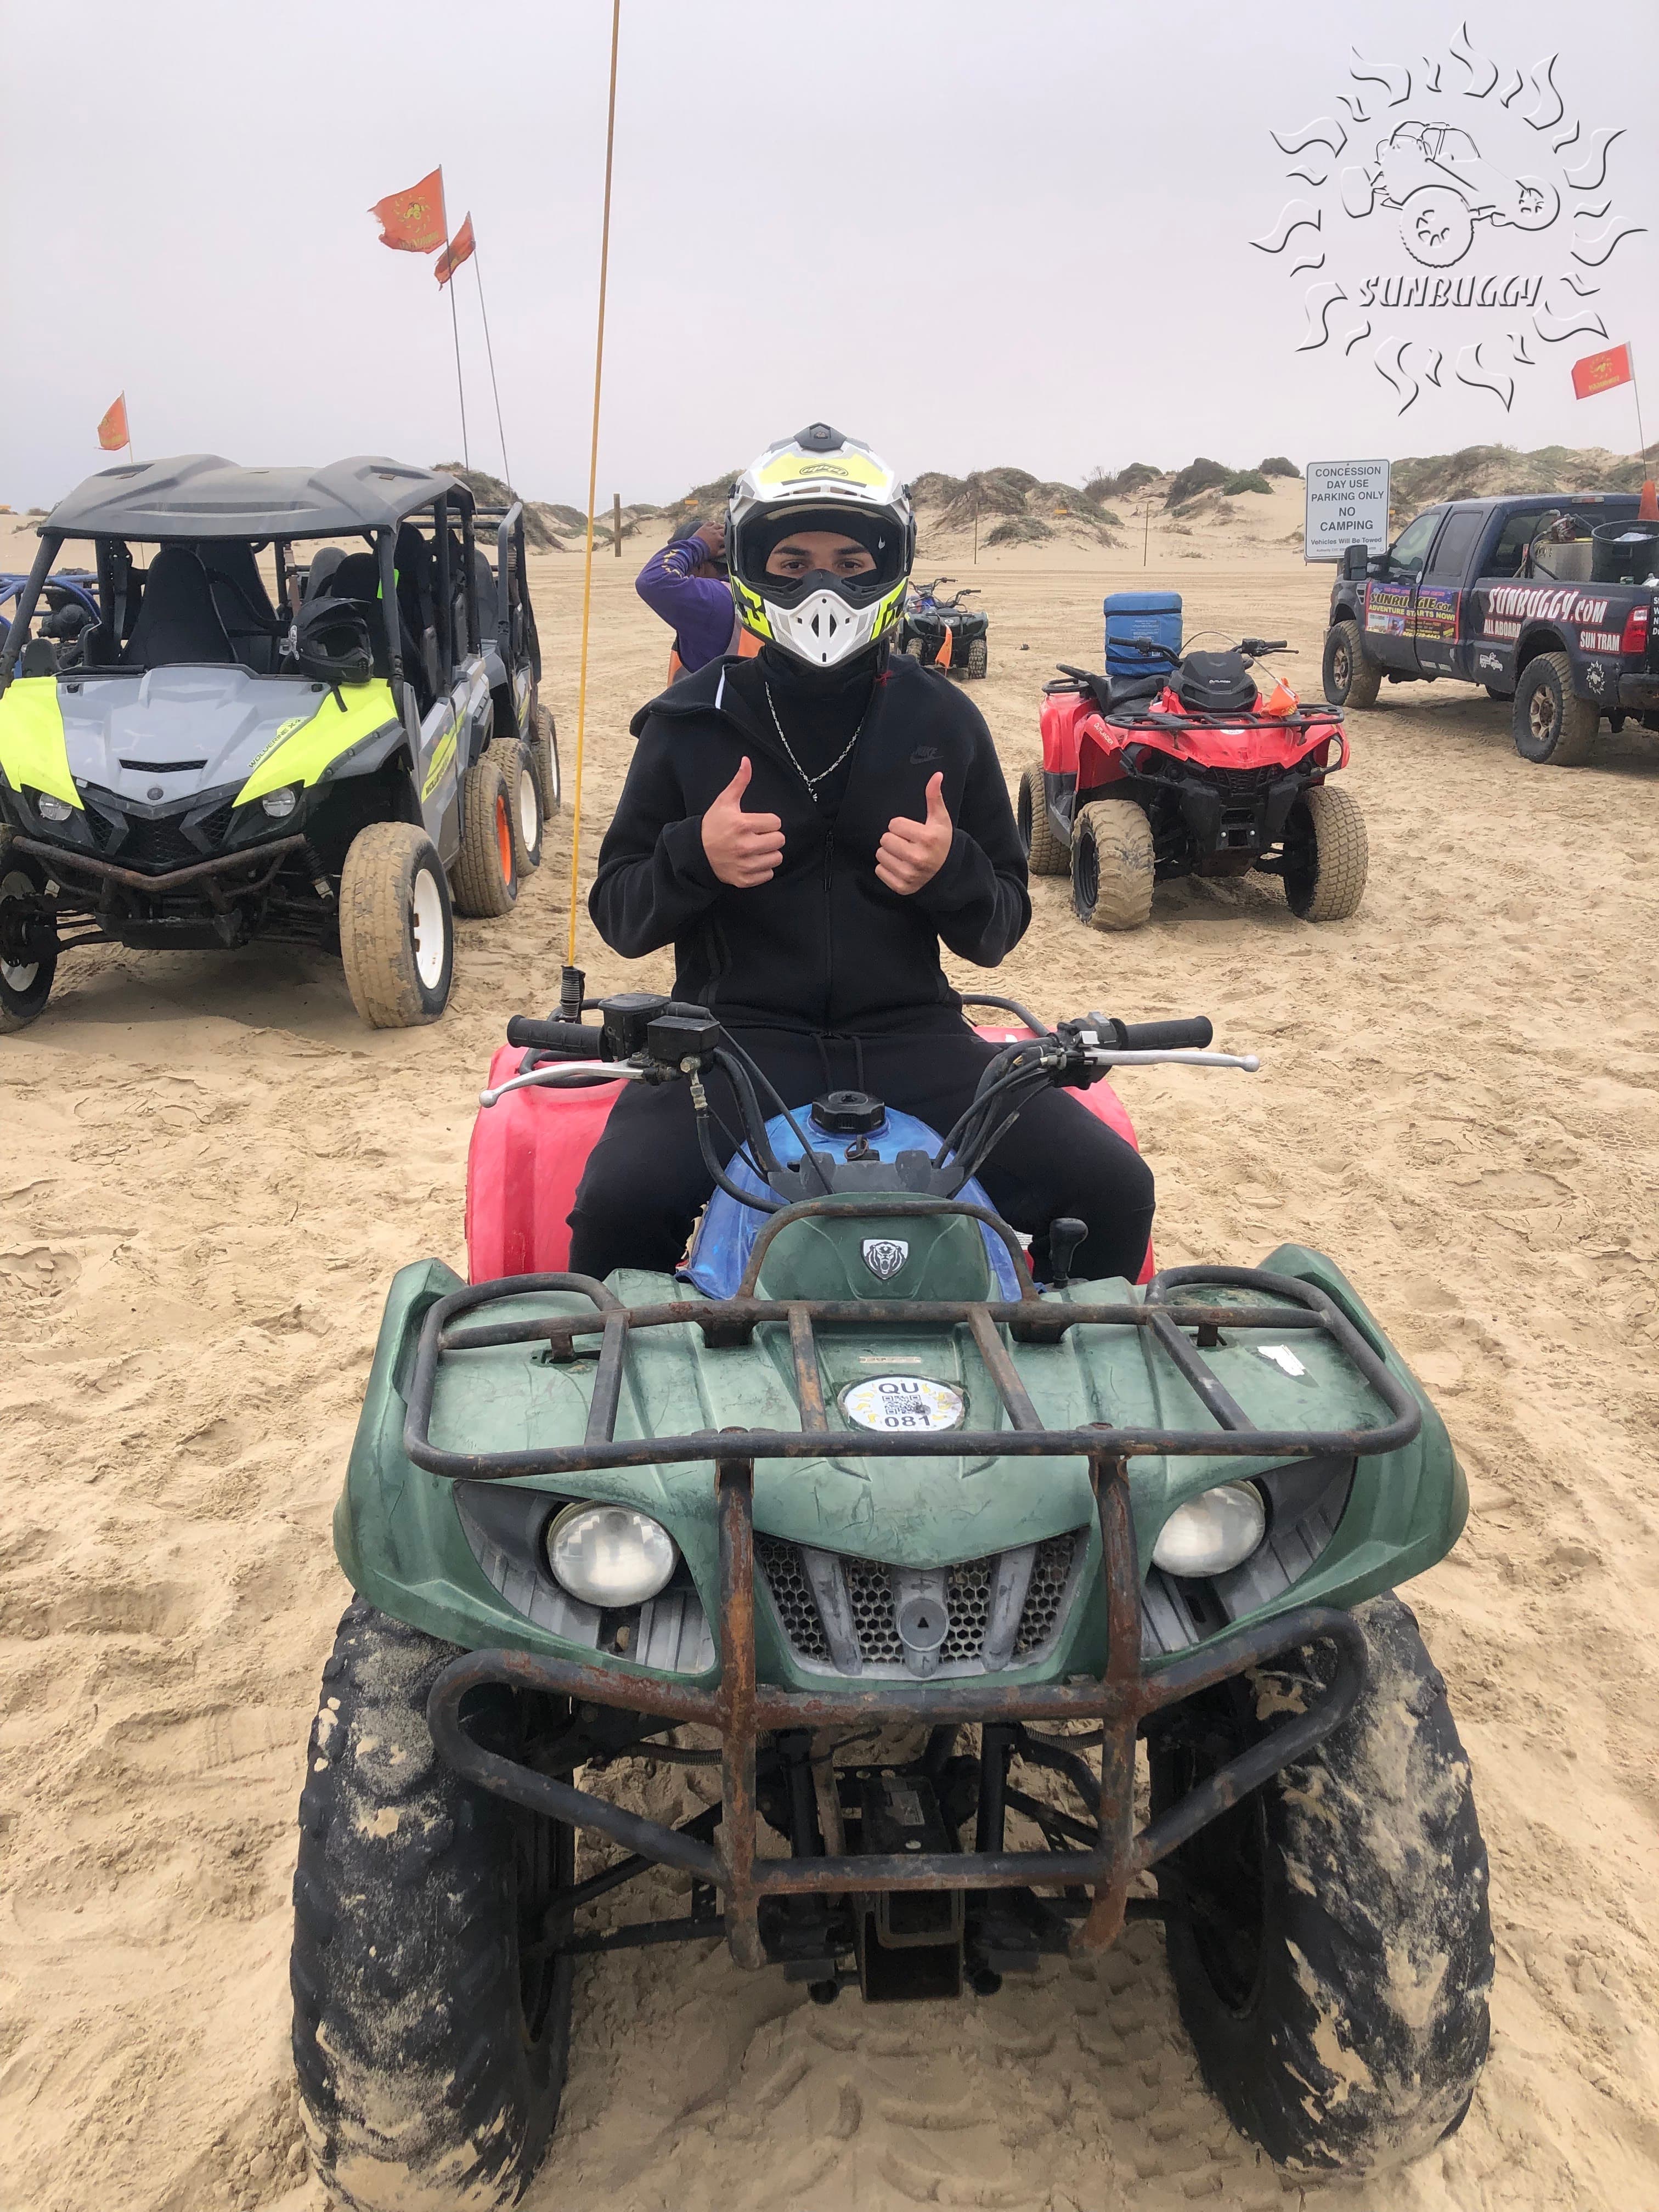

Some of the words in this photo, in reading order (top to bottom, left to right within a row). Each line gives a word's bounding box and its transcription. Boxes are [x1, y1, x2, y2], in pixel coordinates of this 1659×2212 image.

[1315, 466, 1381, 477] CONCESSION
[1327, 480, 1347, 489] DAY
[1349, 479, 1369, 488] USE
[1311, 492, 1355, 502] PARKING
[1358, 491, 1385, 500] ONLY
[1339, 506, 1356, 517] NO
[1320, 520, 1373, 532] CAMPING
[1369, 605, 1405, 615] ADVENTURE
[1406, 610, 1434, 618] STARTS
[1436, 612, 1455, 621] NOW!
[1483, 619, 1494, 634] ALL
[1495, 620, 1522, 638] ABOARD
[1580, 631, 1595, 649] SUN
[1597, 634, 1620, 652] TRAM
[1093, 722, 1114, 746] OUTLANDER
[878, 1383, 919, 1394] QU
[884, 1415, 930, 1427] 081
